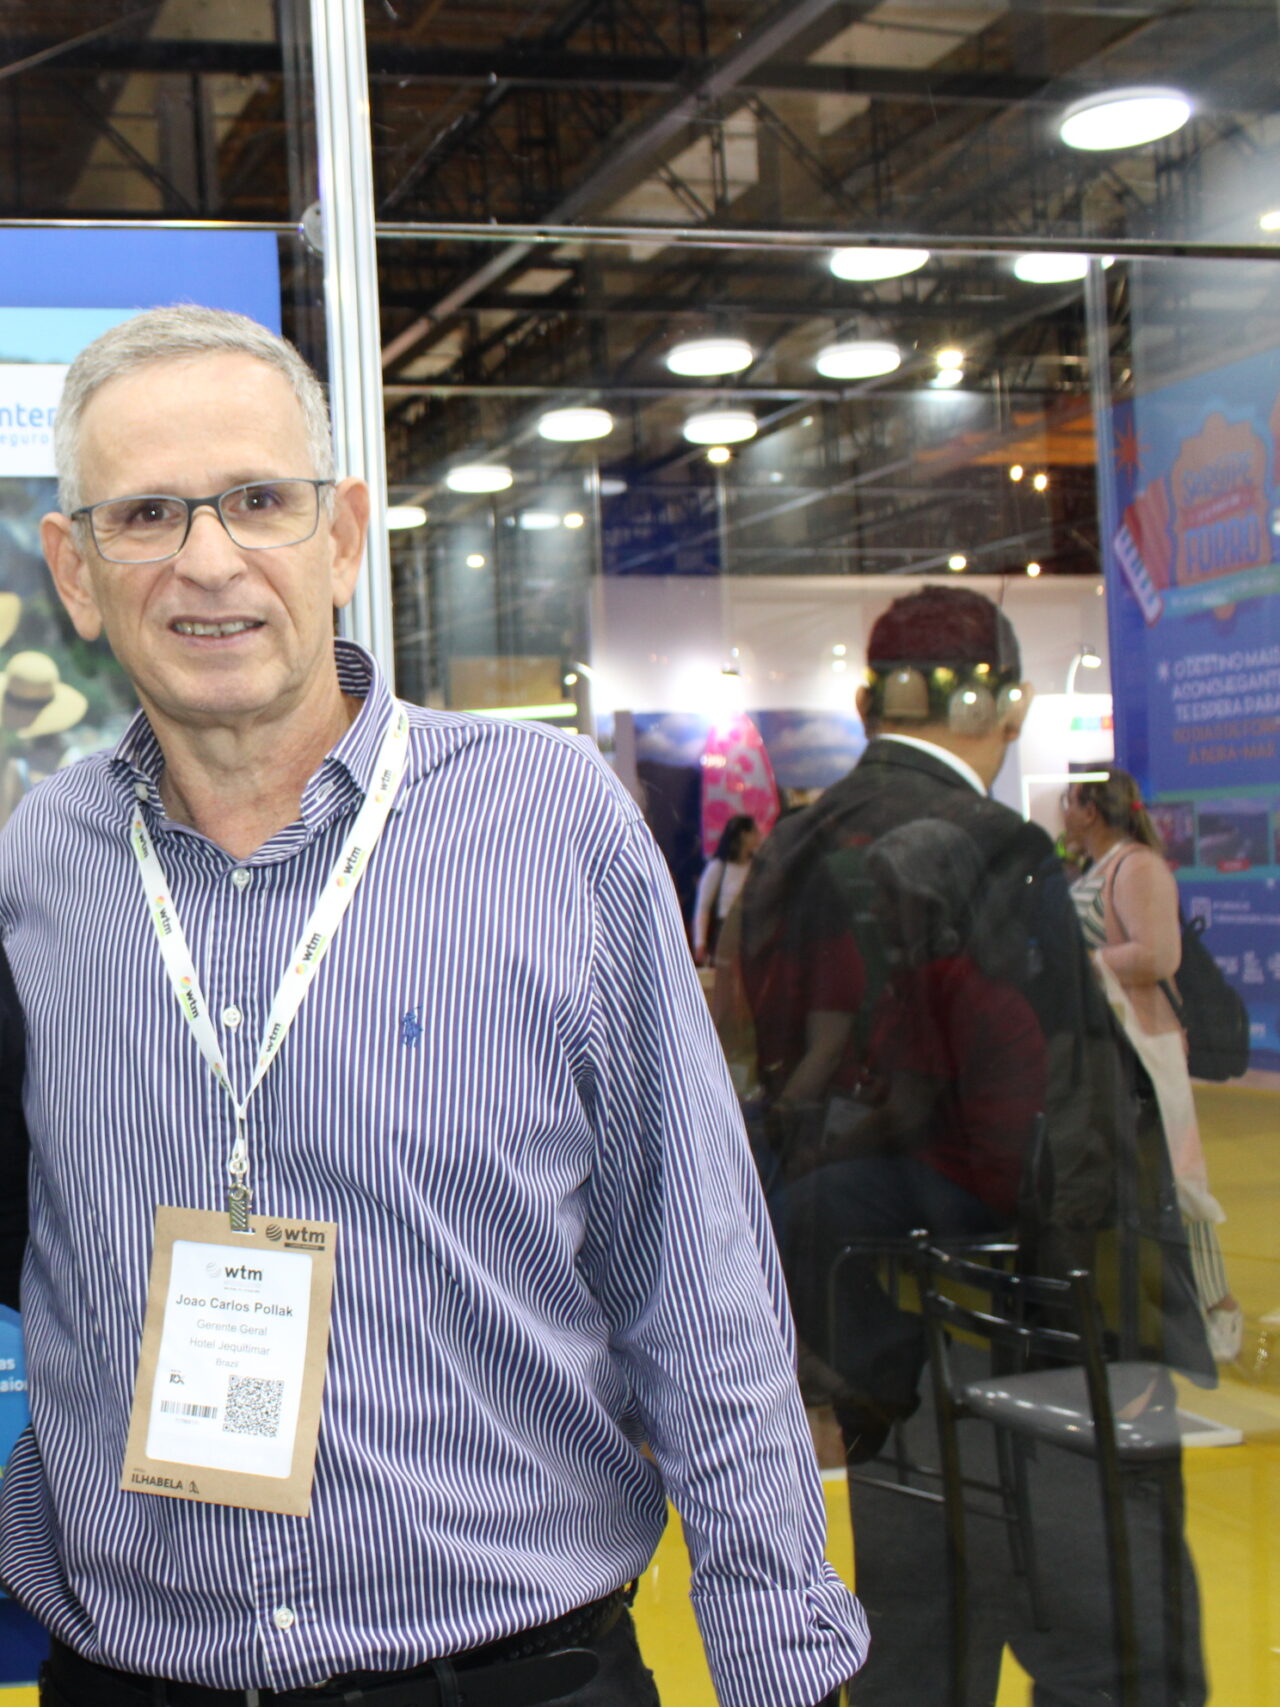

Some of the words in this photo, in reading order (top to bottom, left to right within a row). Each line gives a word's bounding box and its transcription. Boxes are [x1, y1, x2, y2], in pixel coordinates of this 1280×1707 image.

[343, 846, 362, 875] wtm
[159, 908, 172, 935] wtm
[302, 932, 322, 962] wtm
[185, 989, 199, 1019] wtm
[266, 1022, 281, 1052] wtm
[284, 1226, 326, 1243] wtm
[224, 1265, 263, 1282] wtm
[176, 1294, 206, 1308] Joao
[210, 1297, 250, 1312] Carlos
[254, 1302, 293, 1317] Pollak
[196, 1319, 237, 1333] Gerente
[239, 1324, 268, 1336] Geral
[189, 1337, 215, 1349] Hotel
[131, 1473, 183, 1490] ILHABELA
